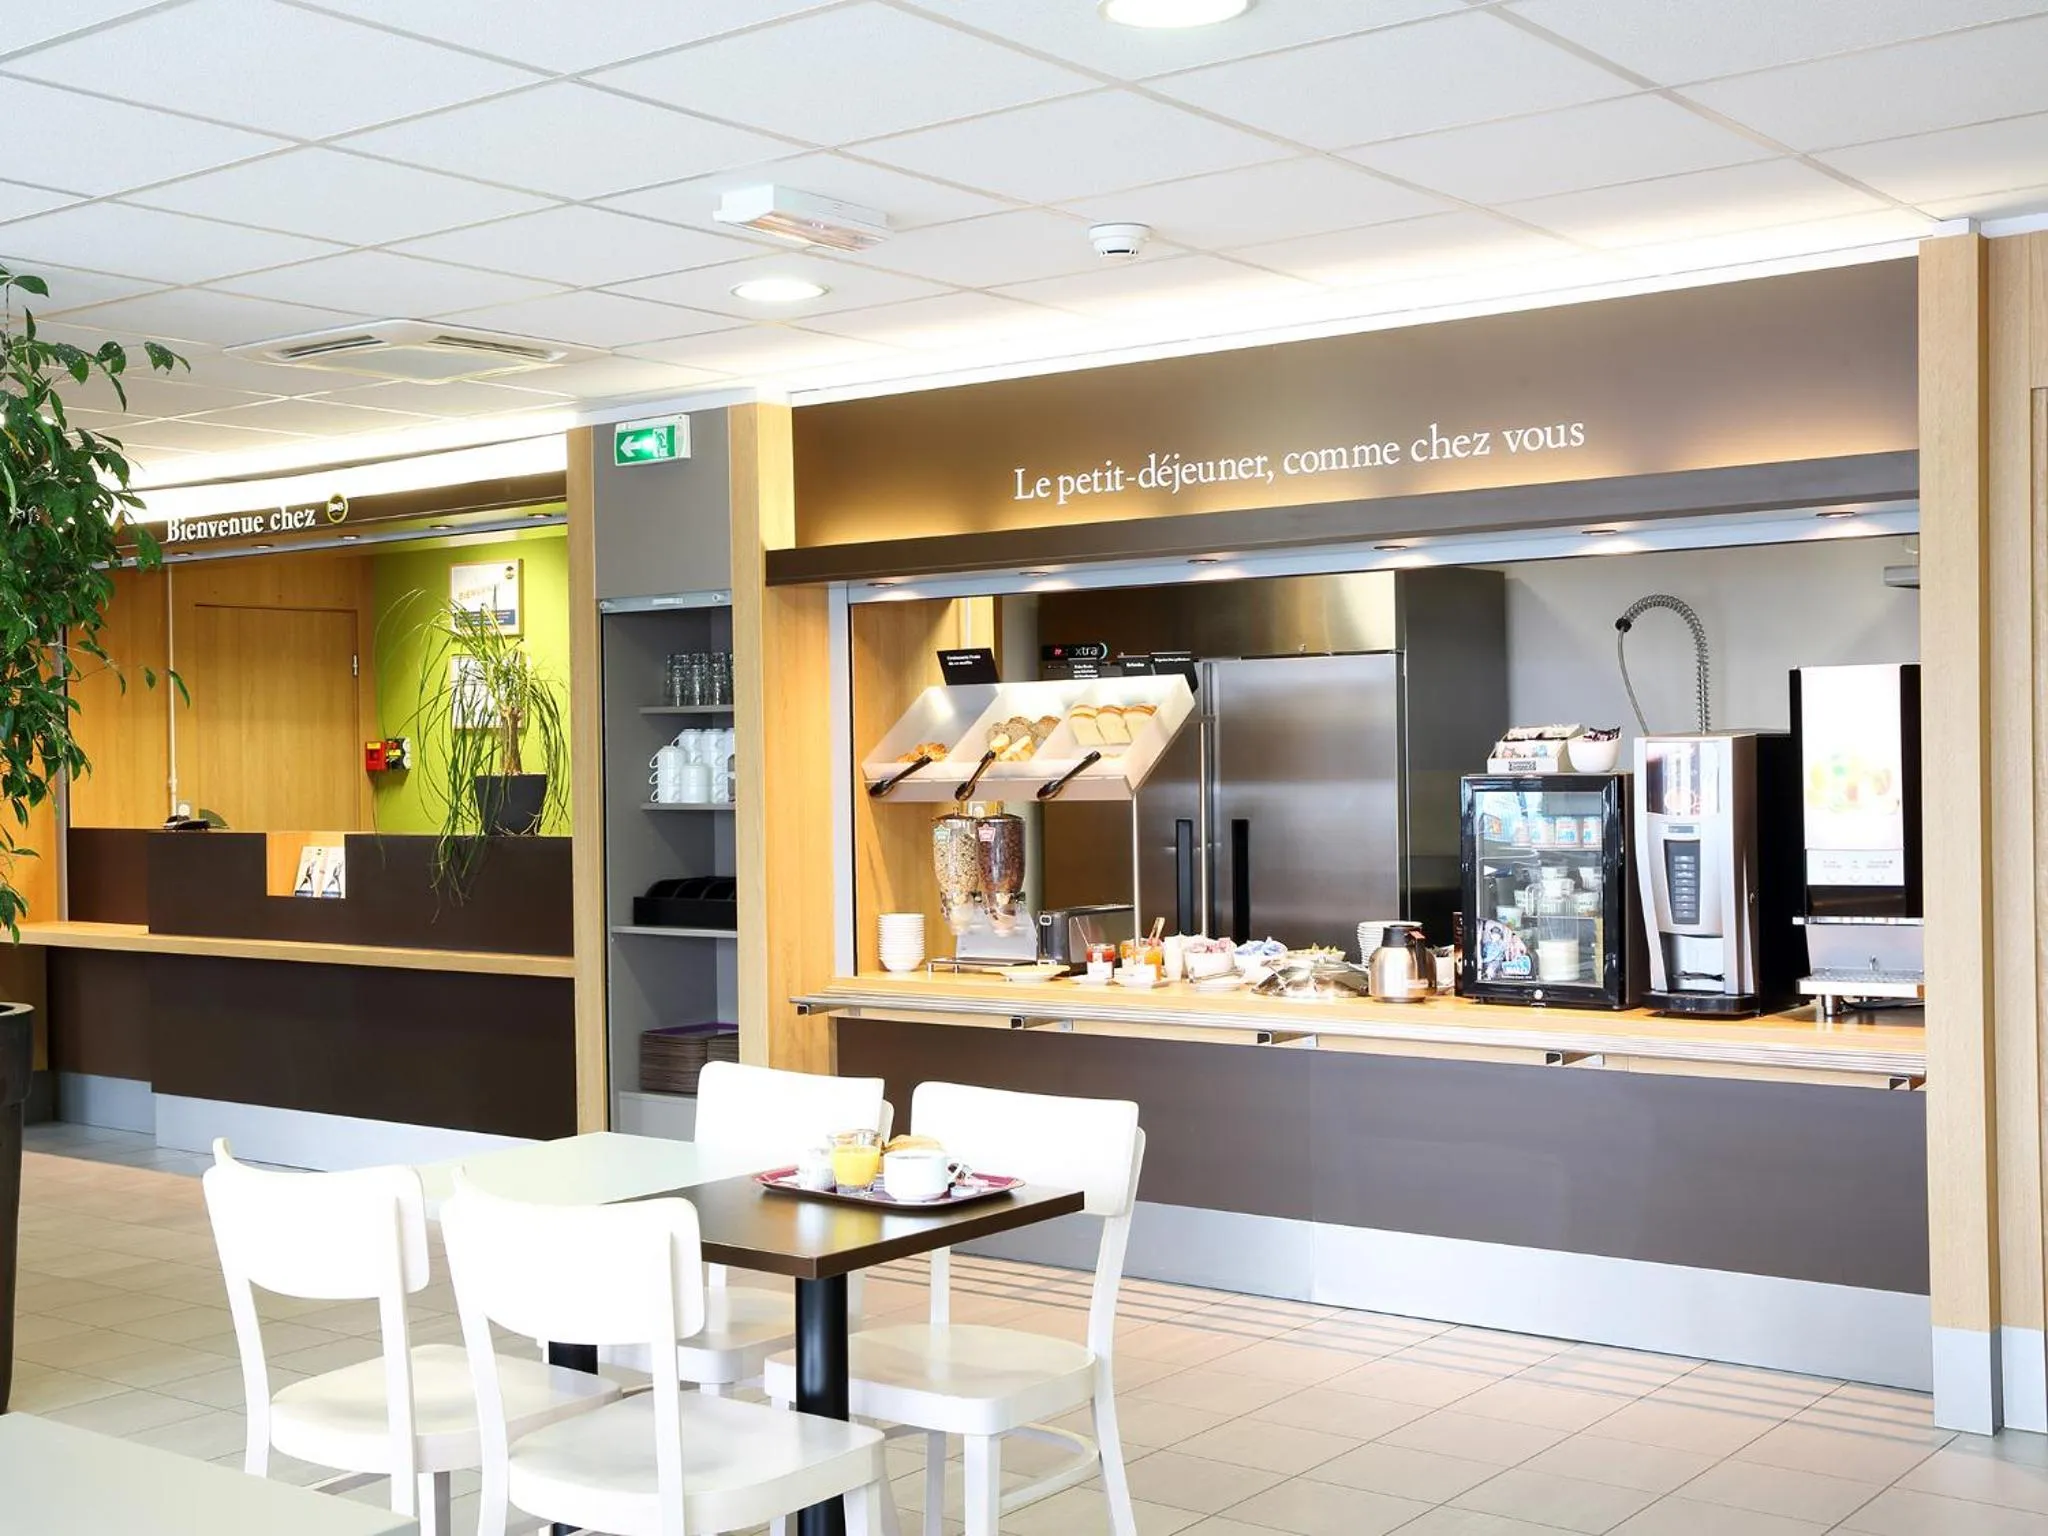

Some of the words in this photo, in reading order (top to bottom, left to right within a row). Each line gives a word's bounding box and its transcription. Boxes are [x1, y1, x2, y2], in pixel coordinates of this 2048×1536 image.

[1013, 467, 1051, 500] Le
[1056, 453, 1276, 505] petit-déjeuner,
[1282, 440, 1401, 475] comme
[1410, 422, 1491, 463] chez
[1502, 421, 1586, 454] vous
[166, 515, 265, 543] Bienvenue
[269, 506, 317, 533] chez
